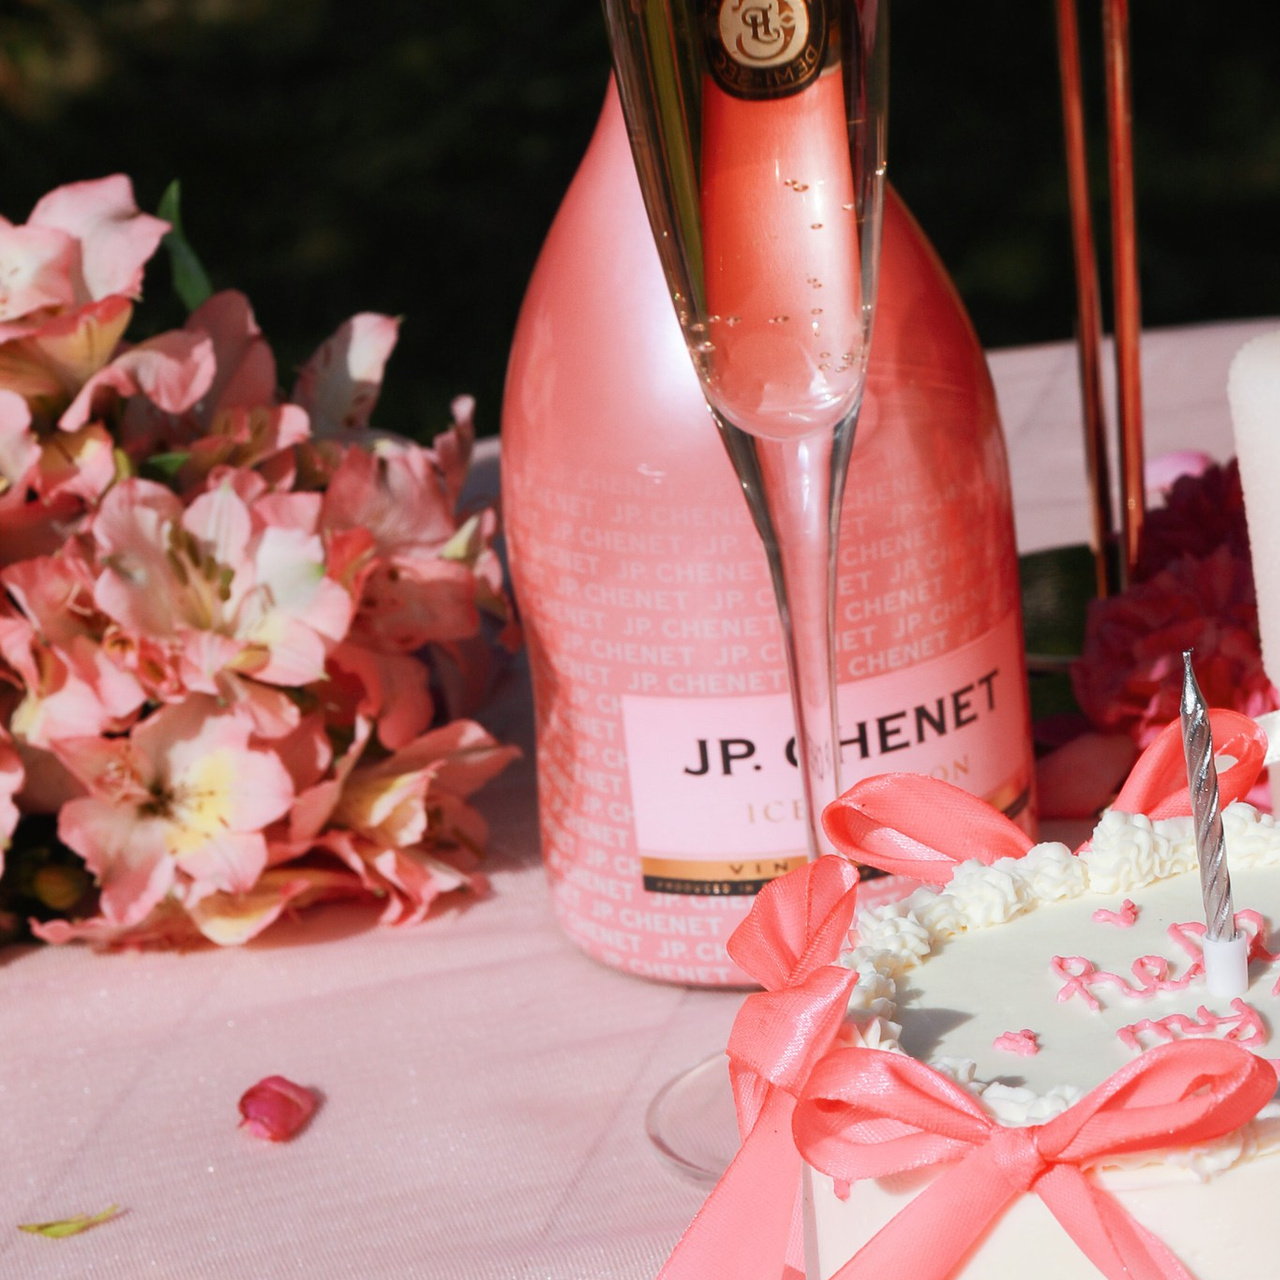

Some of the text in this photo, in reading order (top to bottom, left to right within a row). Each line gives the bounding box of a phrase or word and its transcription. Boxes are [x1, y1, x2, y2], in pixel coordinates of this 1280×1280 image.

[590, 637, 696, 668] CHENET
[683, 737, 762, 778] JP.
[619, 907, 724, 937] CHENET
